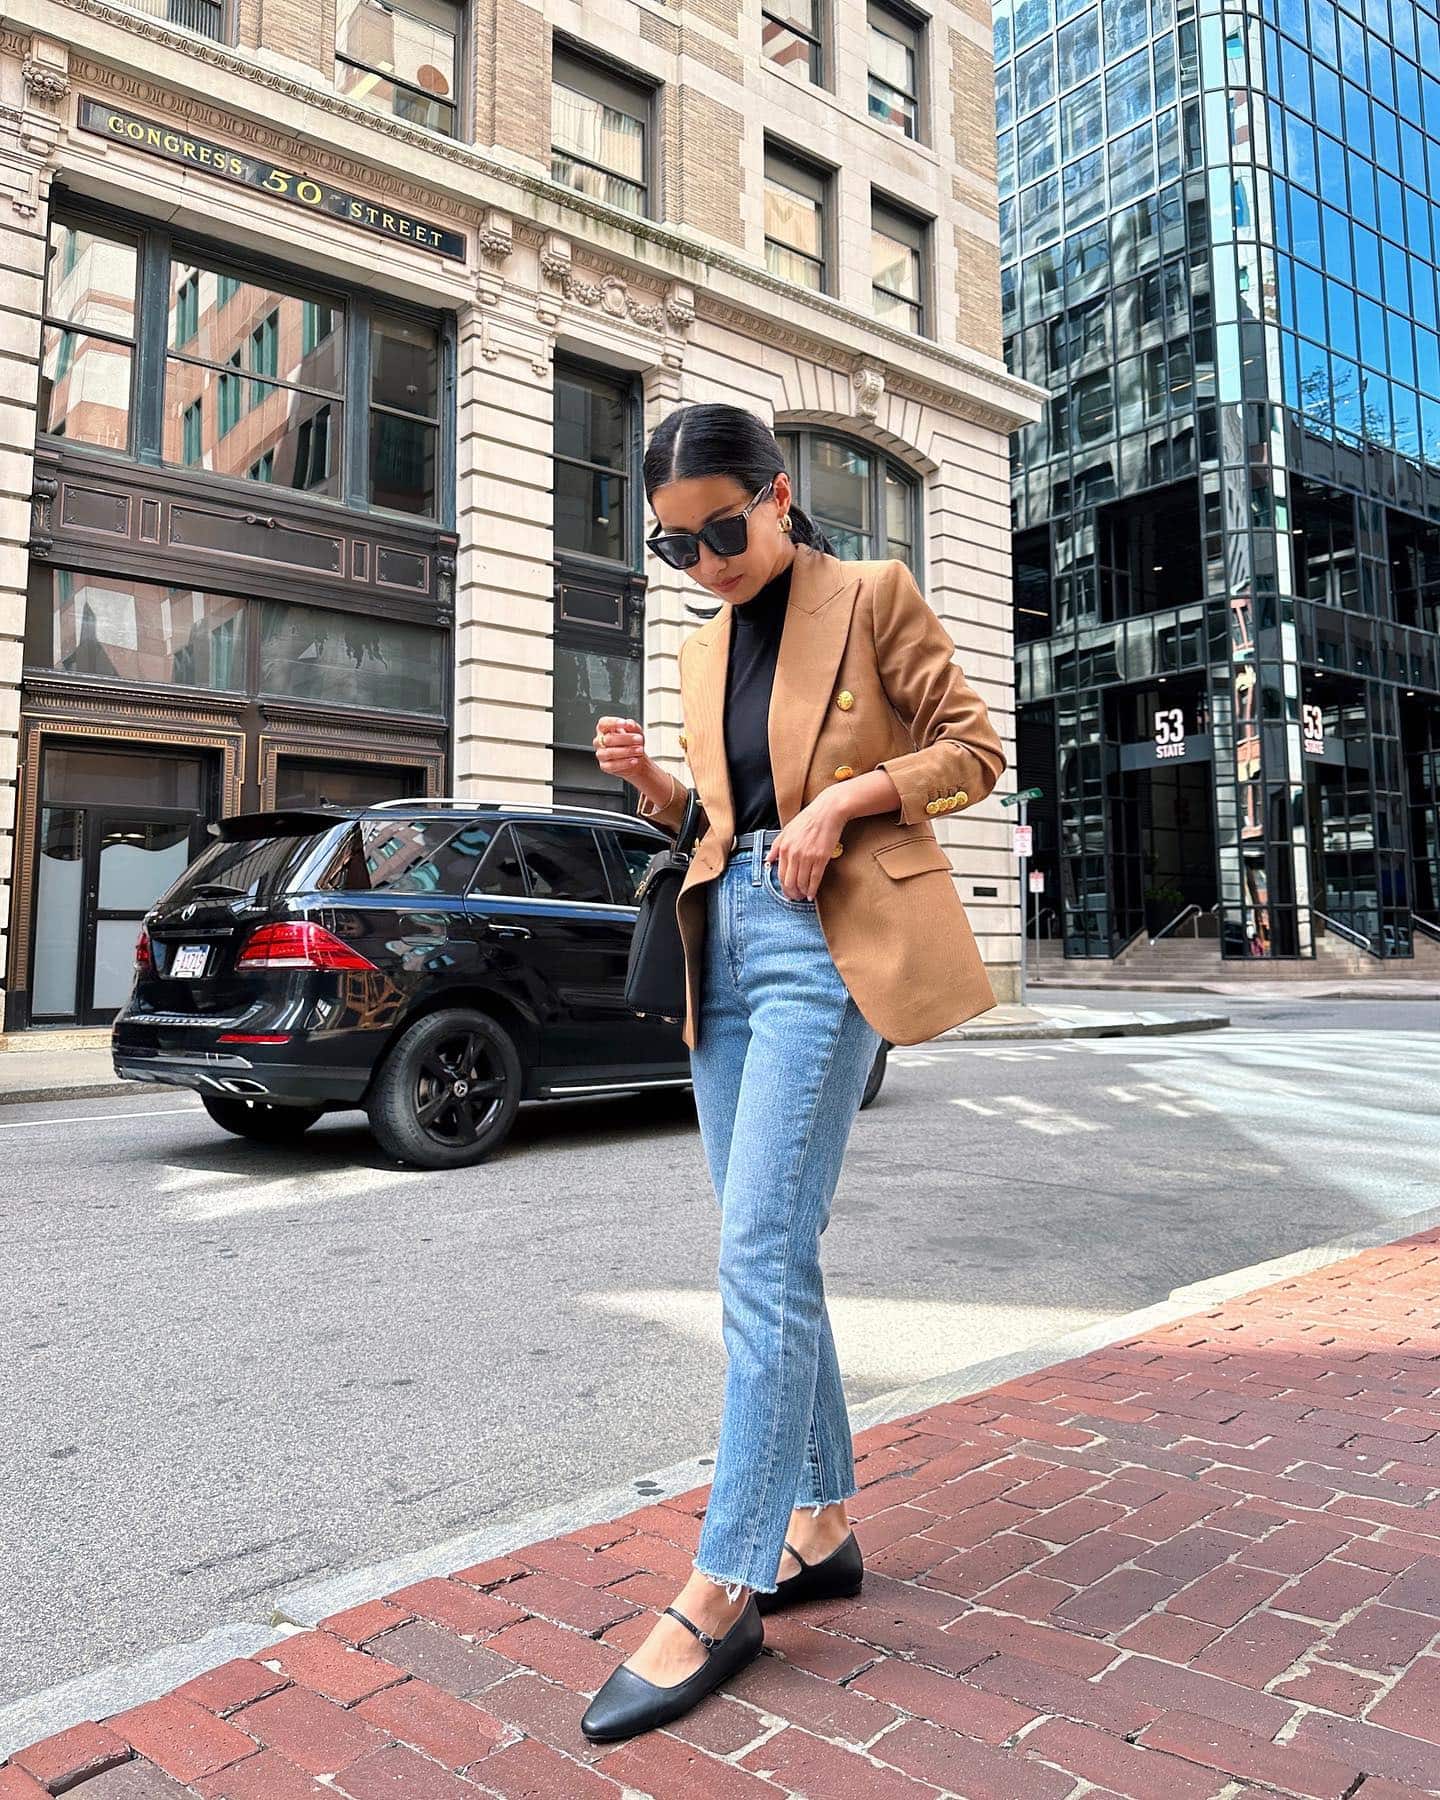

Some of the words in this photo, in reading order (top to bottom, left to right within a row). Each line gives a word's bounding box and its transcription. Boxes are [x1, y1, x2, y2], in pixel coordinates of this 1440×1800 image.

[108, 116, 242, 175] CONGRESS
[262, 169, 322, 205] 50
[350, 202, 442, 247] STREET
[1155, 708, 1184, 745] 53
[1303, 704, 1323, 740] 53
[1156, 742, 1185, 759] STATE
